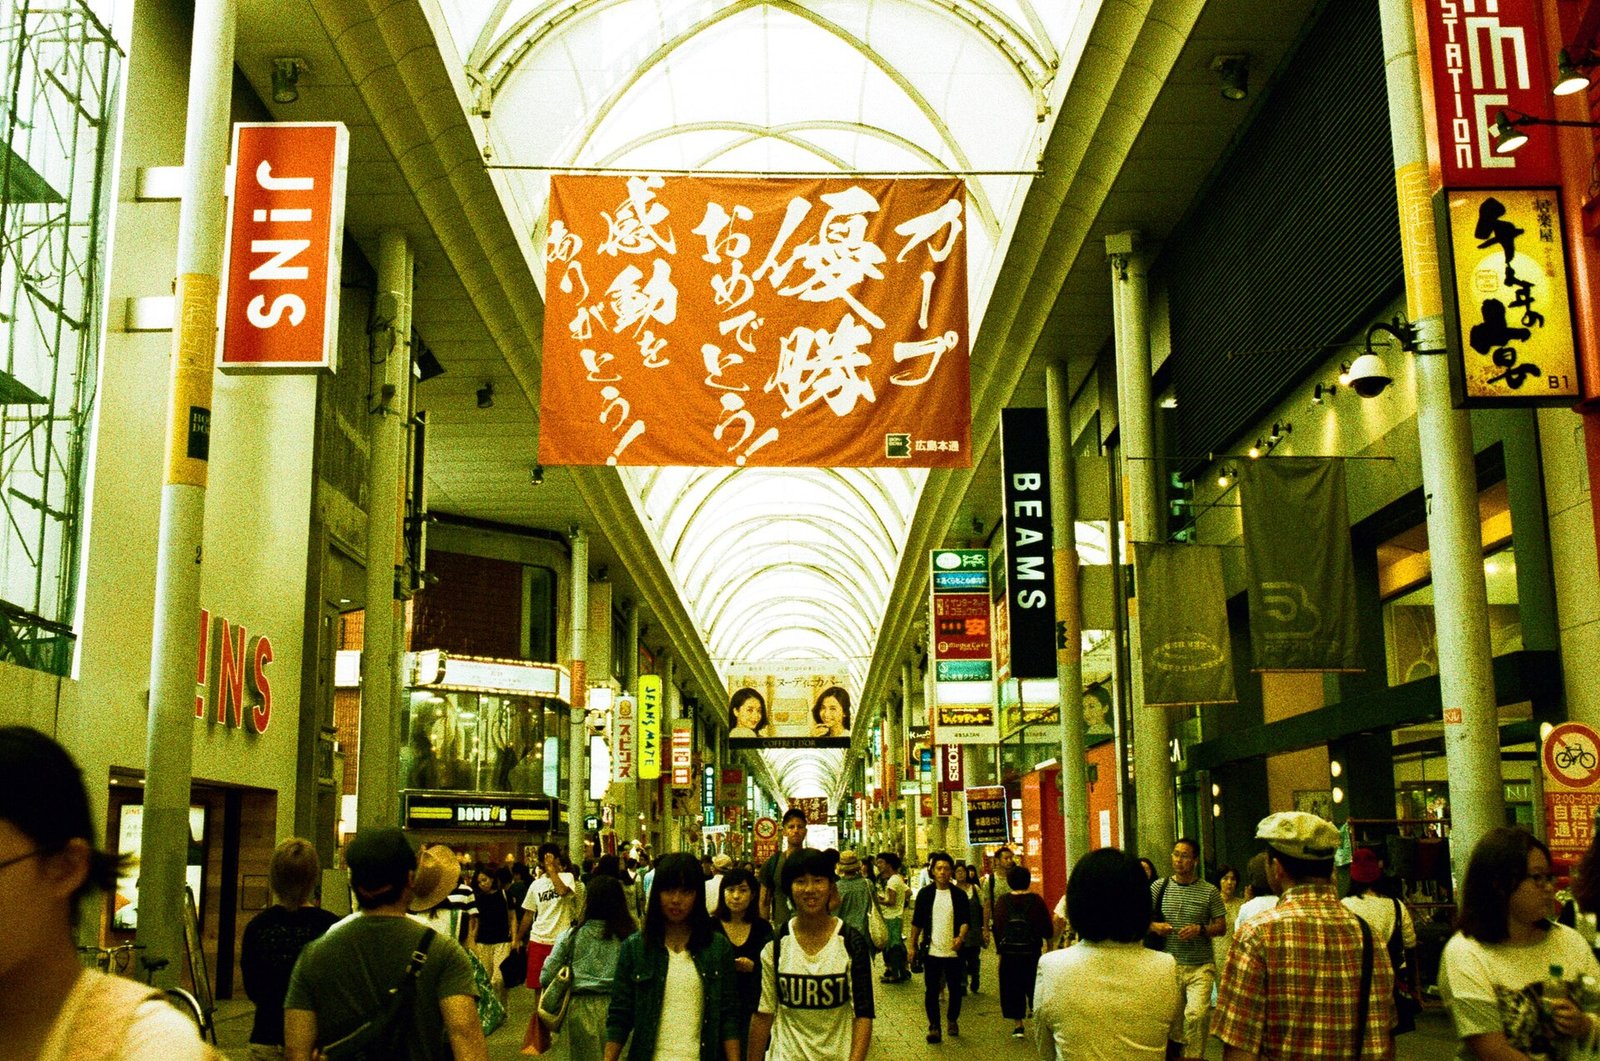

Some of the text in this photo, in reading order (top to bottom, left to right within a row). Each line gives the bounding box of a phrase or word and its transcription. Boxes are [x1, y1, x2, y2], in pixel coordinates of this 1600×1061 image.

[598, 175, 678, 368] 感動を
[753, 185, 886, 418] 優勝
[889, 198, 965, 387] カープ
[1549, 376, 1569, 389] B1
[915, 440, 959, 452] 広島本通
[1013, 473, 1047, 609] BEAMS
[619, 724, 631, 778] スピンズ
[642, 686, 656, 766] JEANS MATE
[1554, 821, 1596, 837] 通行
